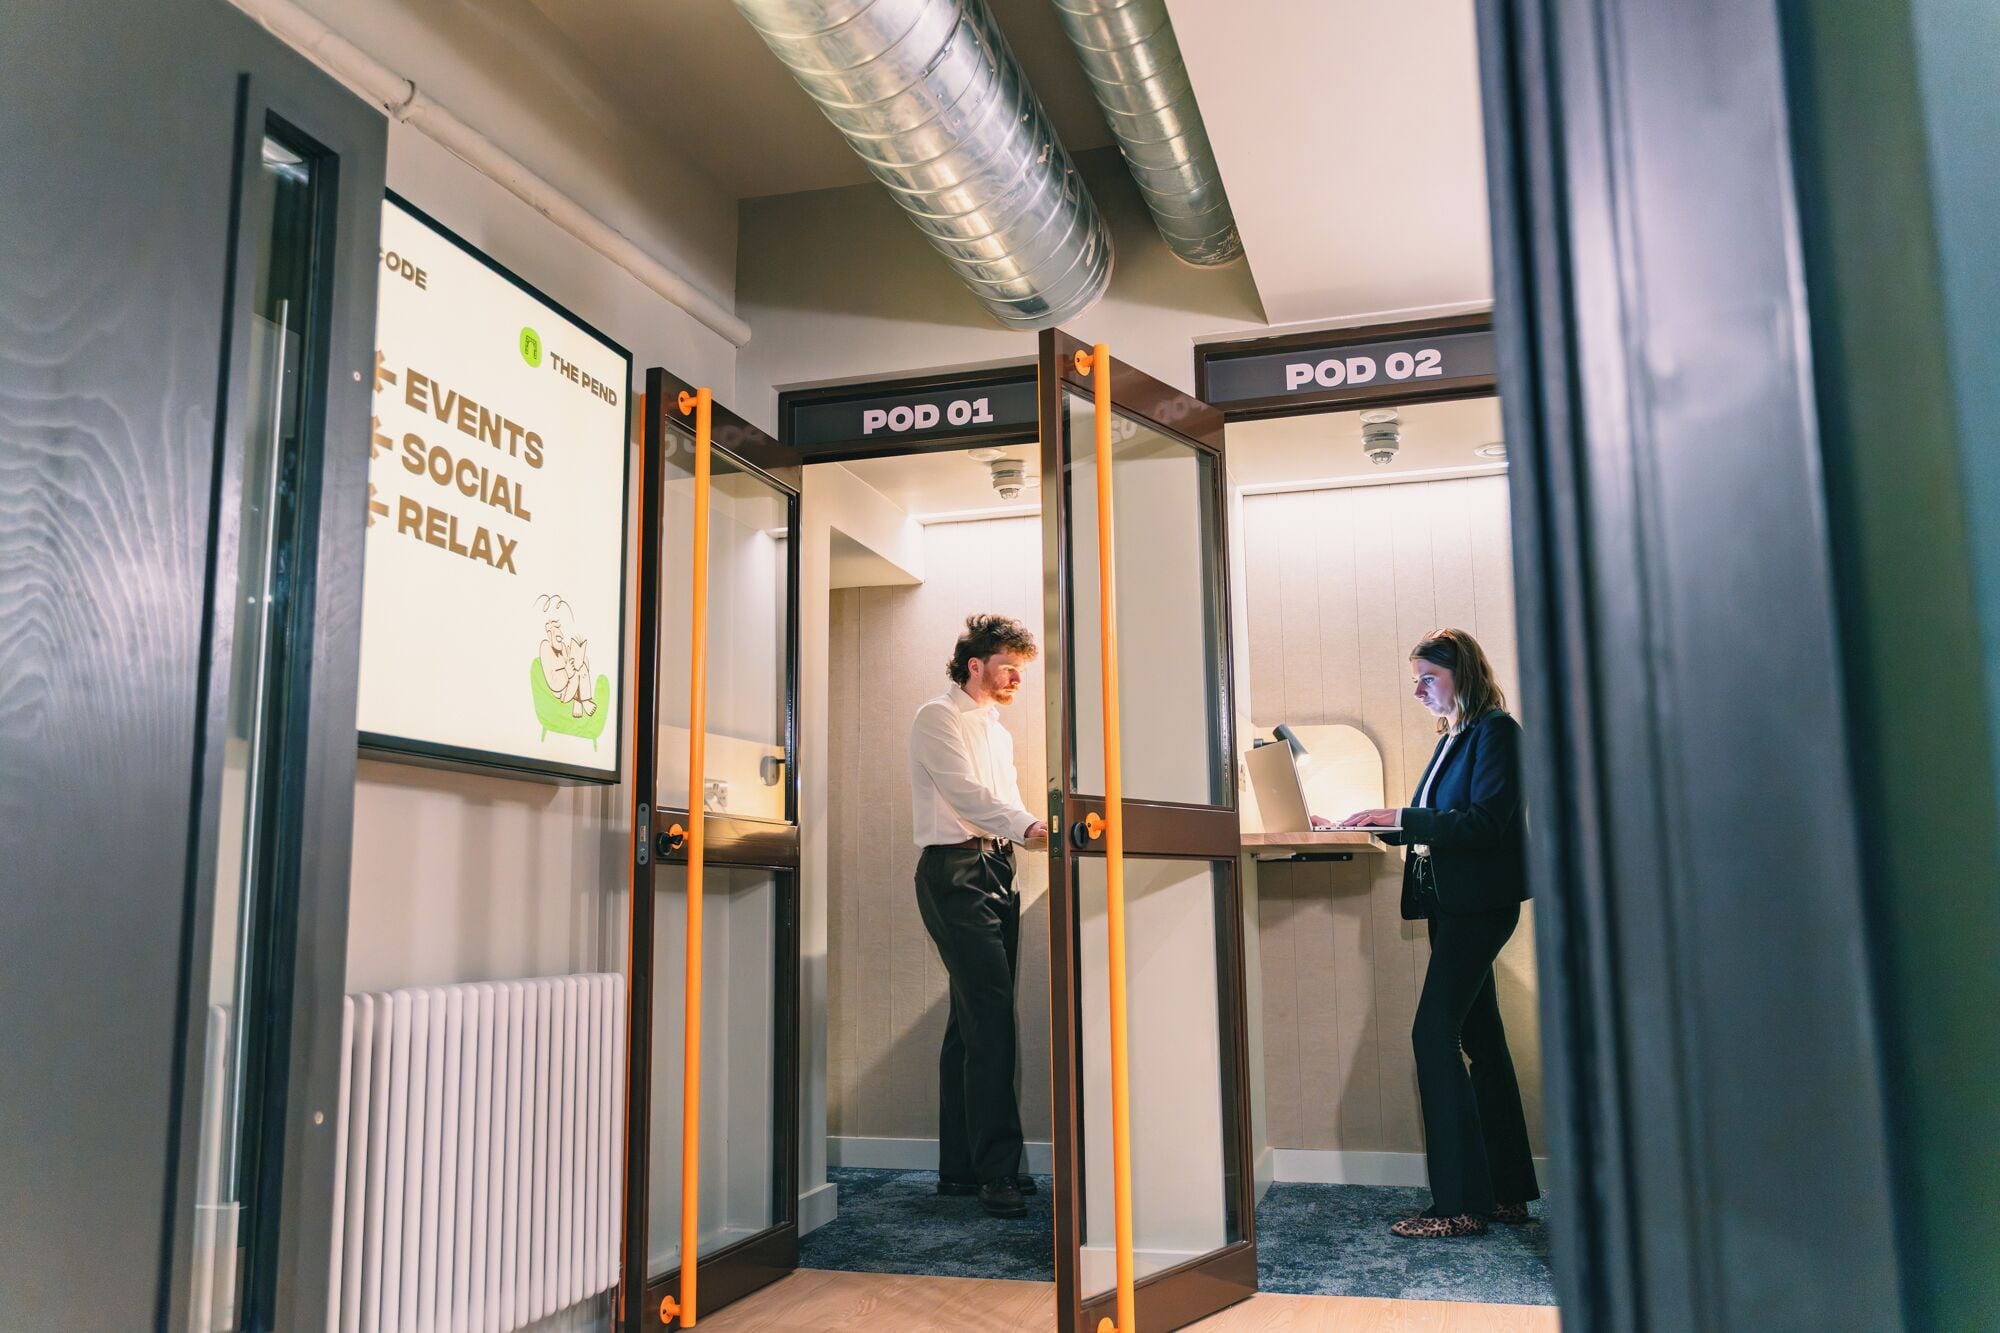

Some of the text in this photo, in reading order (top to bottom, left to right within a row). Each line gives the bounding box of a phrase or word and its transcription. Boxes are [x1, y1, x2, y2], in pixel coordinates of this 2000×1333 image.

[379, 246, 427, 291] ODE
[550, 351, 618, 407] THE PEND
[1285, 349, 1443, 391] POD 02
[405, 367, 544, 470] EVENTS
[863, 397, 994, 434] POD 01
[401, 432, 531, 522] SOCIAL
[398, 494, 518, 575] RELAX
